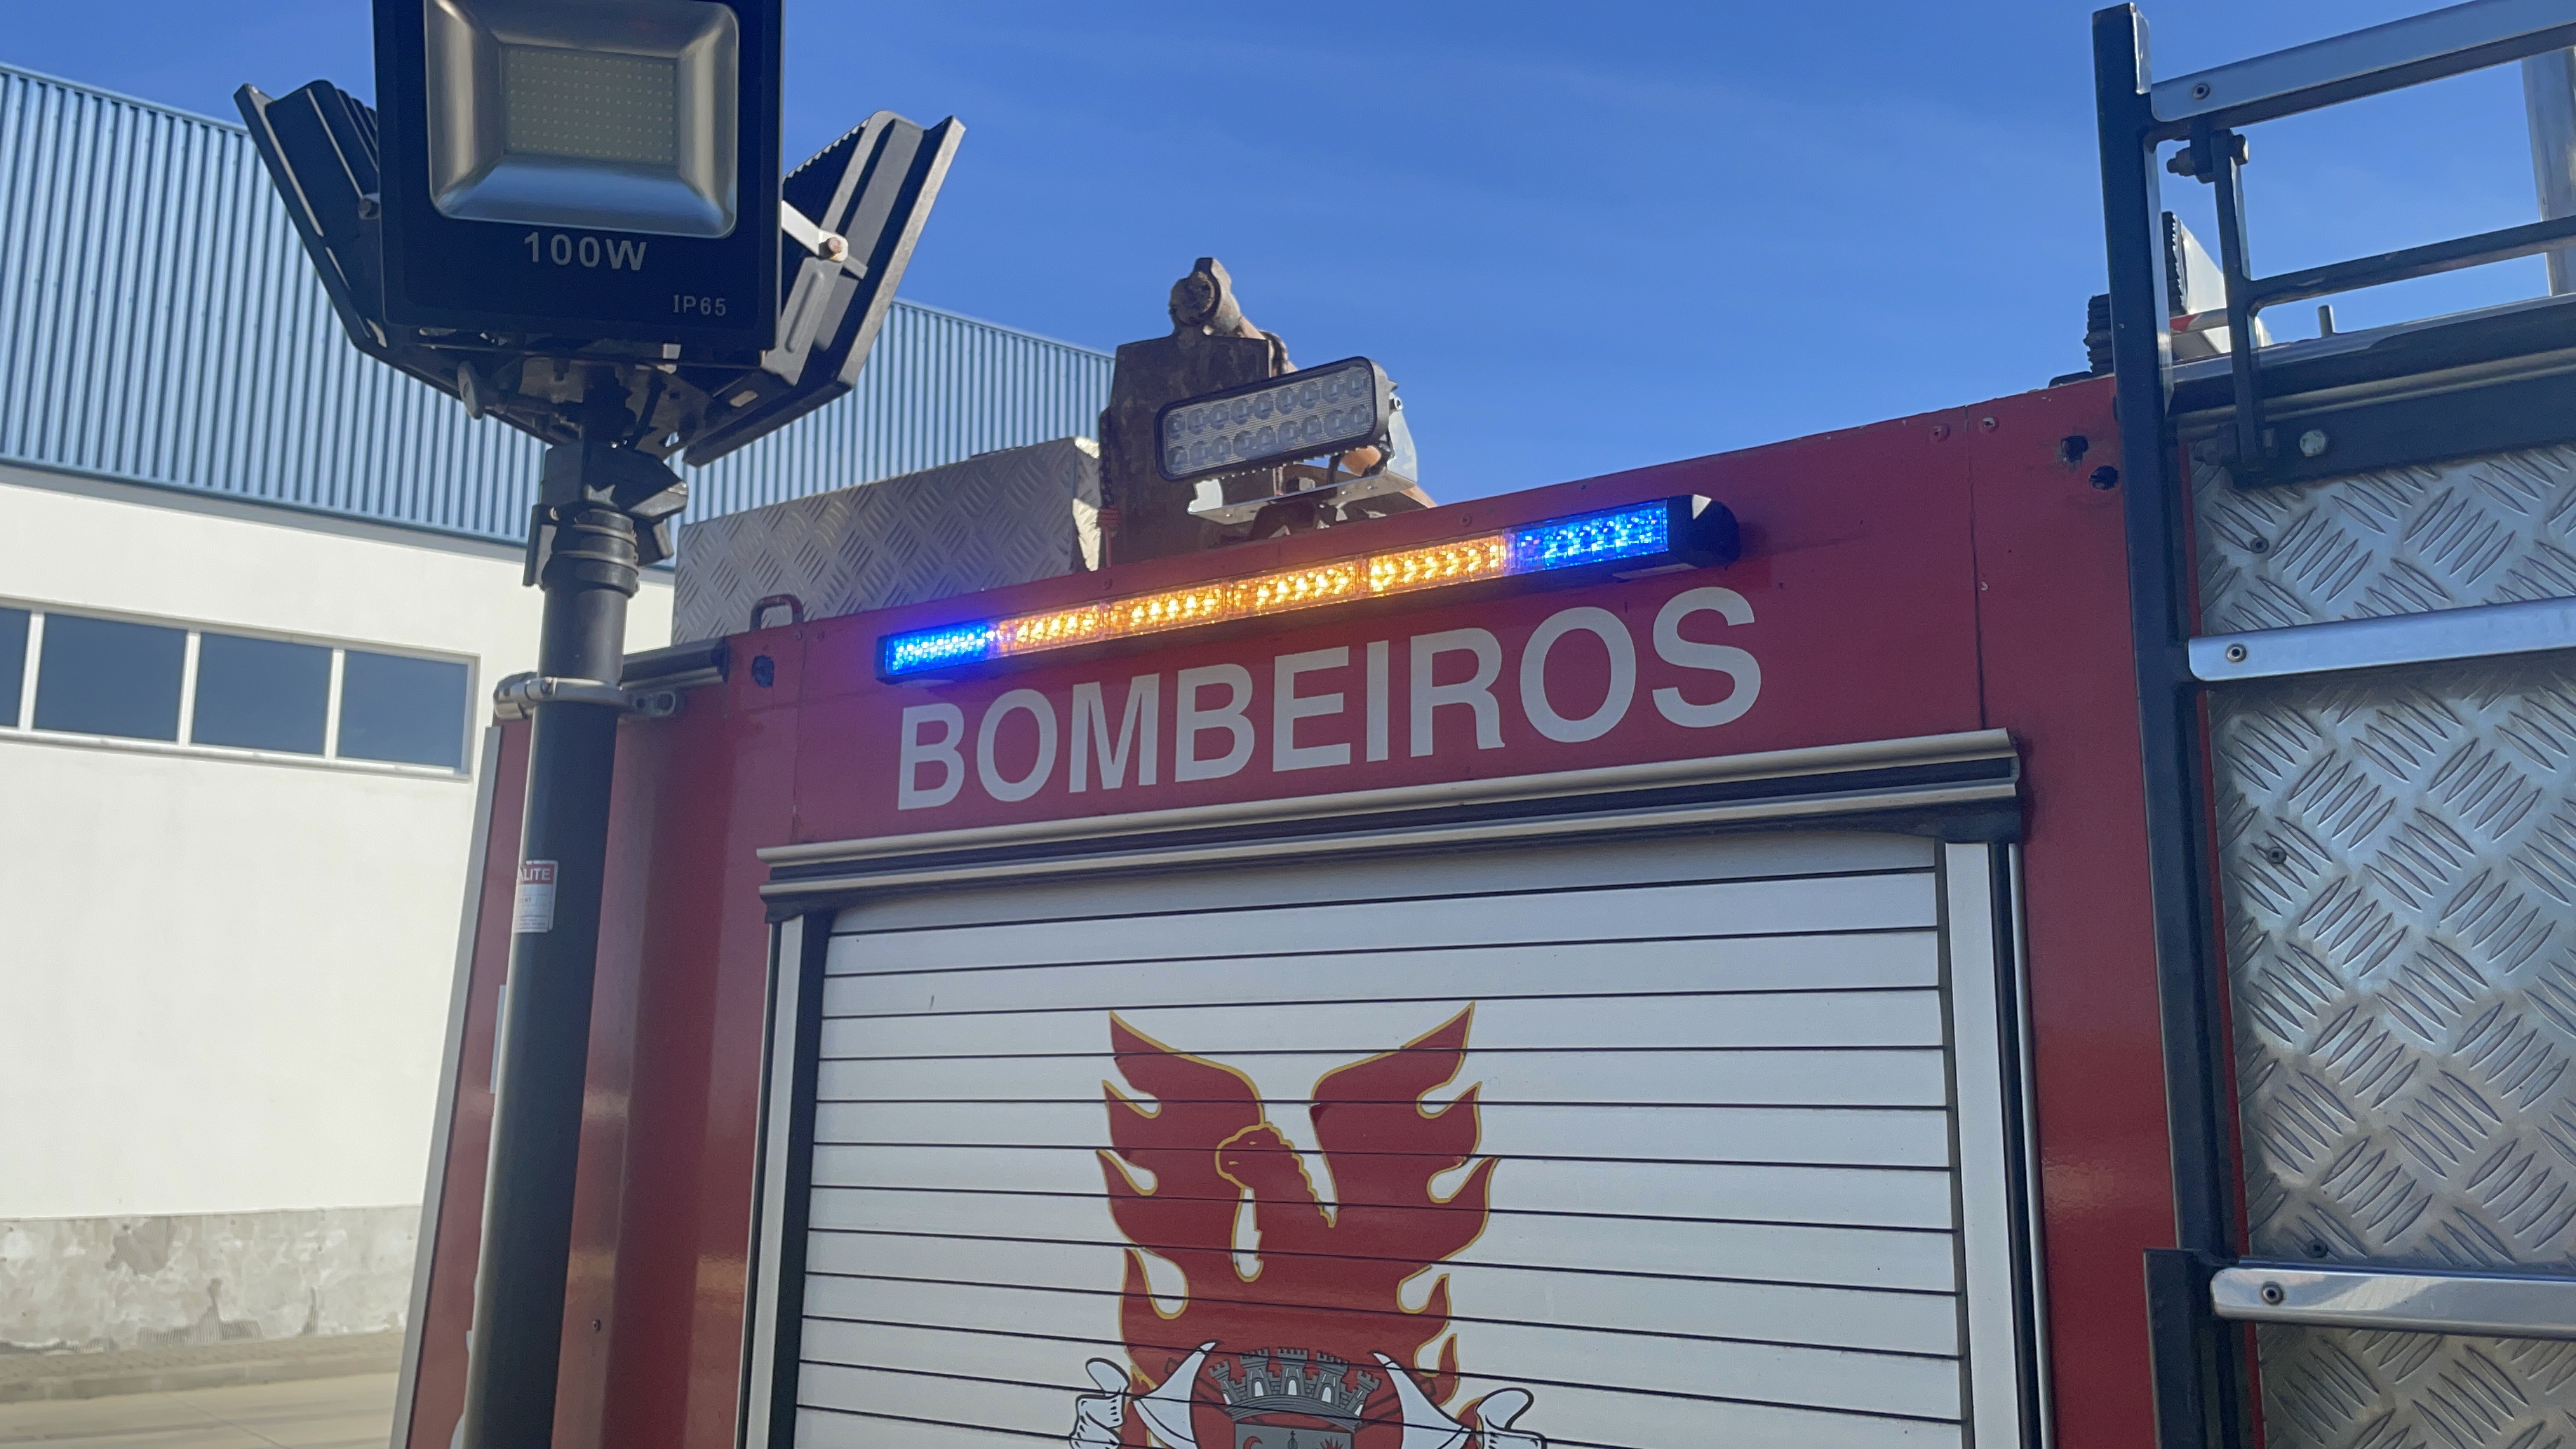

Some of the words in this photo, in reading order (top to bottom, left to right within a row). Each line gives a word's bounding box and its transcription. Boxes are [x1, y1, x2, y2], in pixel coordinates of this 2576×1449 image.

[524, 232, 647, 271] 100W
[673, 295, 727, 316] IP65
[897, 587, 1762, 810] BOMBEIROS
